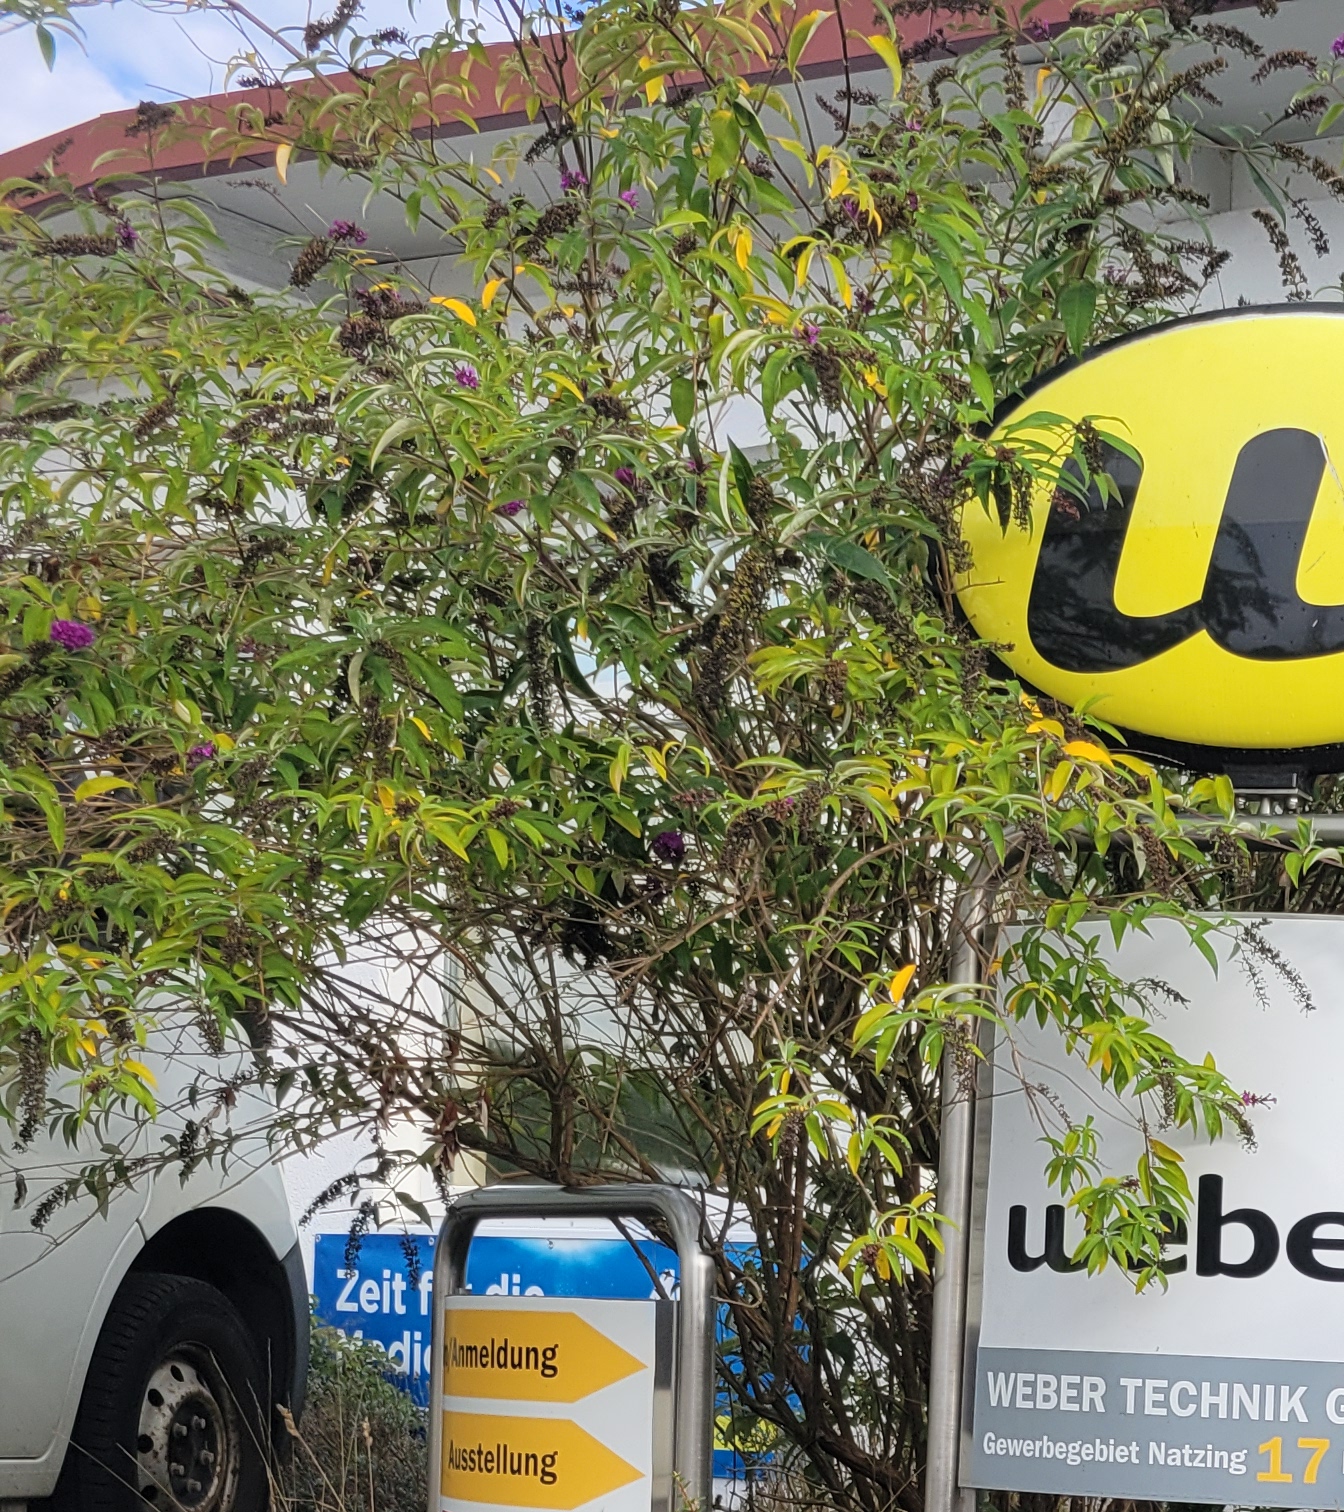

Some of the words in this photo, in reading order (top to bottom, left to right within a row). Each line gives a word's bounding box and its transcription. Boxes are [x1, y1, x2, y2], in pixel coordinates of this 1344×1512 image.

[335, 1268, 407, 1315] Zeit
[987, 1371, 1107, 1413] WEBER
[1119, 1377, 1309, 1423] TECHNIK
[448, 1439, 559, 1486] Ausstellung
[983, 1431, 1140, 1465] Gewerbegebiet
[1148, 1441, 1248, 1475] Natzing
[1256, 1436, 1331, 1484] 17
